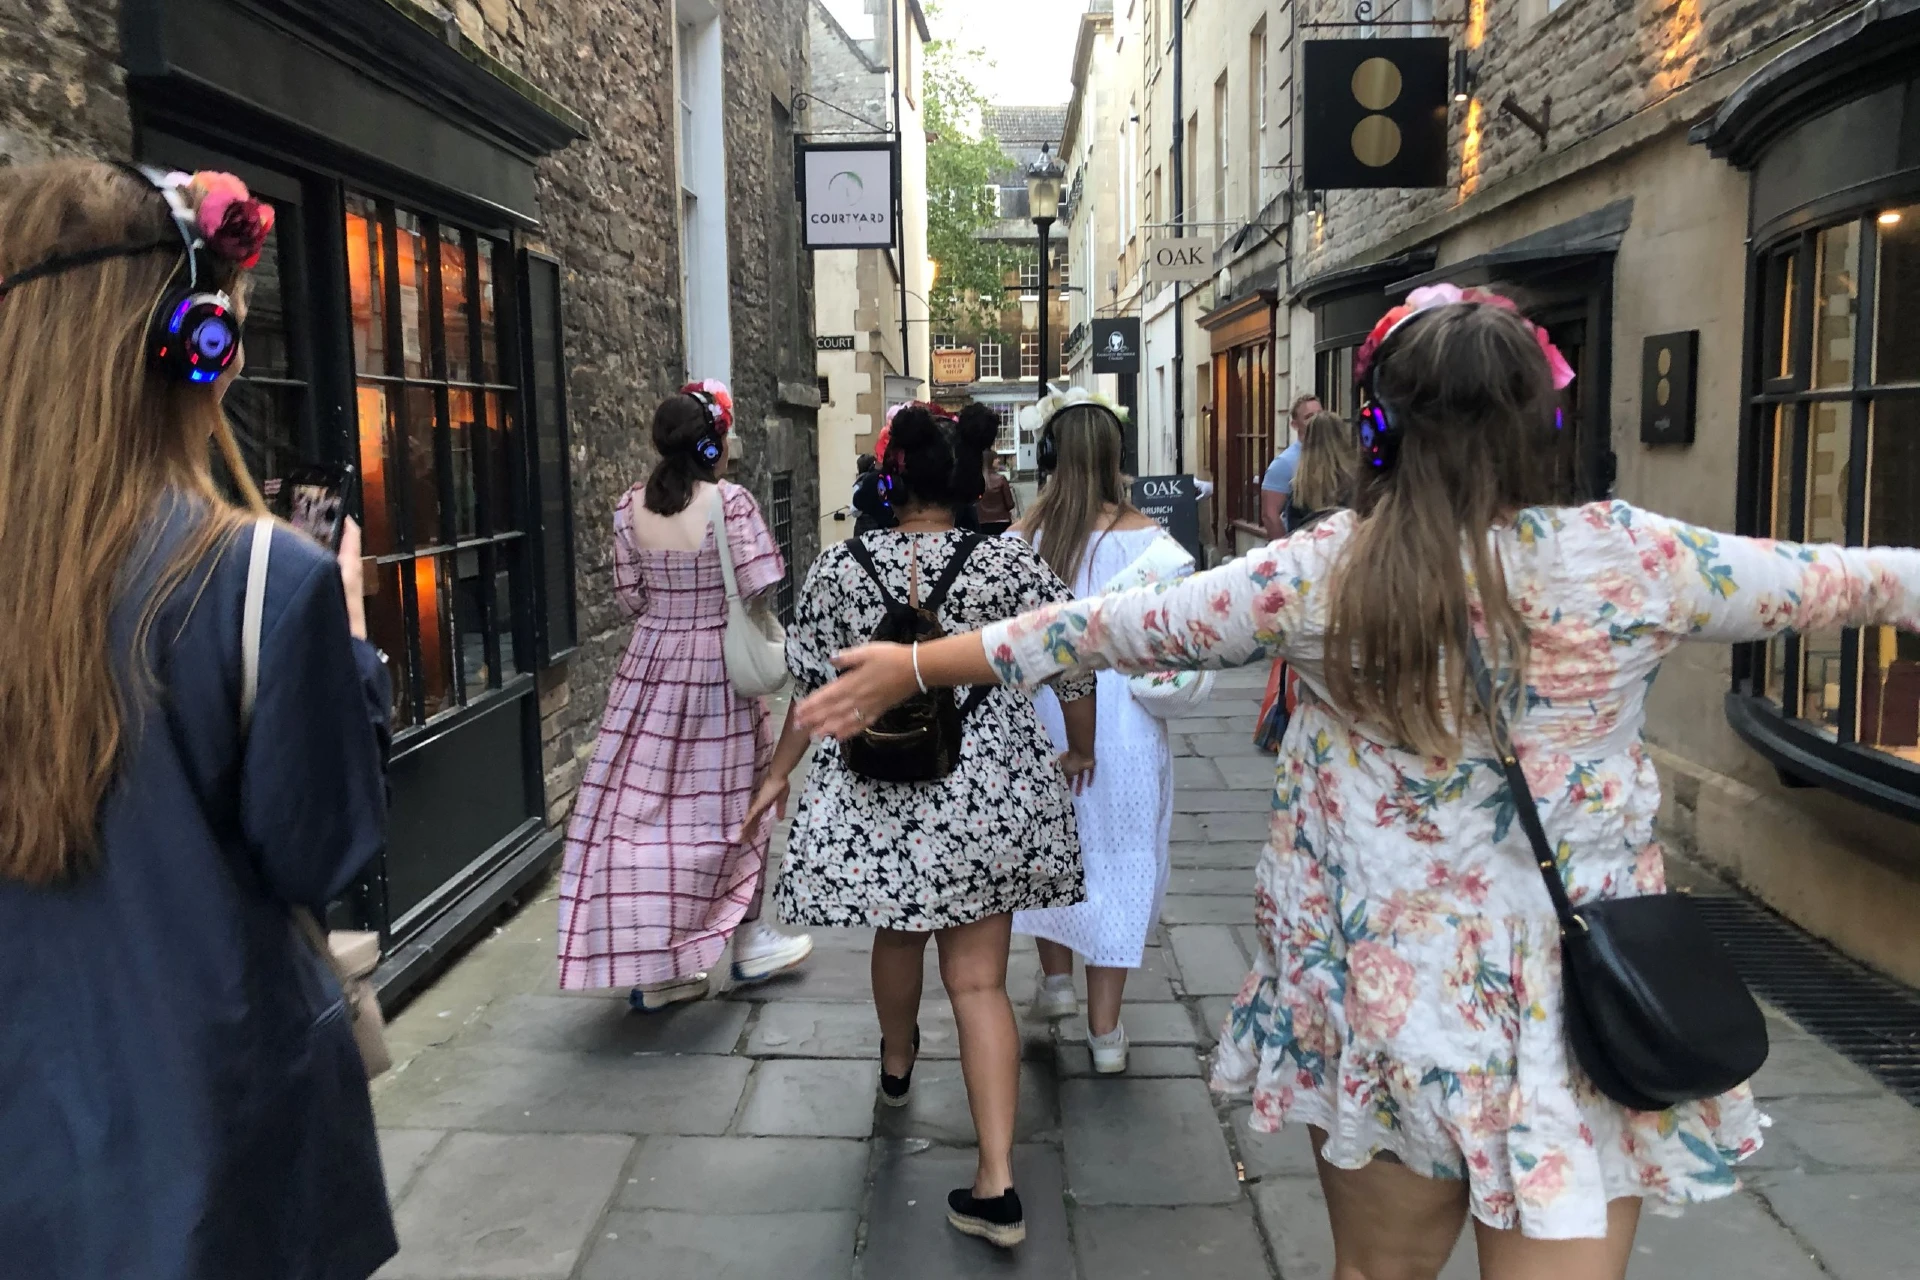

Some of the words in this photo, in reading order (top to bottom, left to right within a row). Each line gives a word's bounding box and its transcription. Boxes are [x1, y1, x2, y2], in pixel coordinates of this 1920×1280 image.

[811, 213, 884, 224] COURTYARD
[1156, 246, 1206, 267] OAK
[816, 337, 852, 349] COURT
[1143, 480, 1184, 496] OAK
[1140, 505, 1173, 515] BRUNCH
